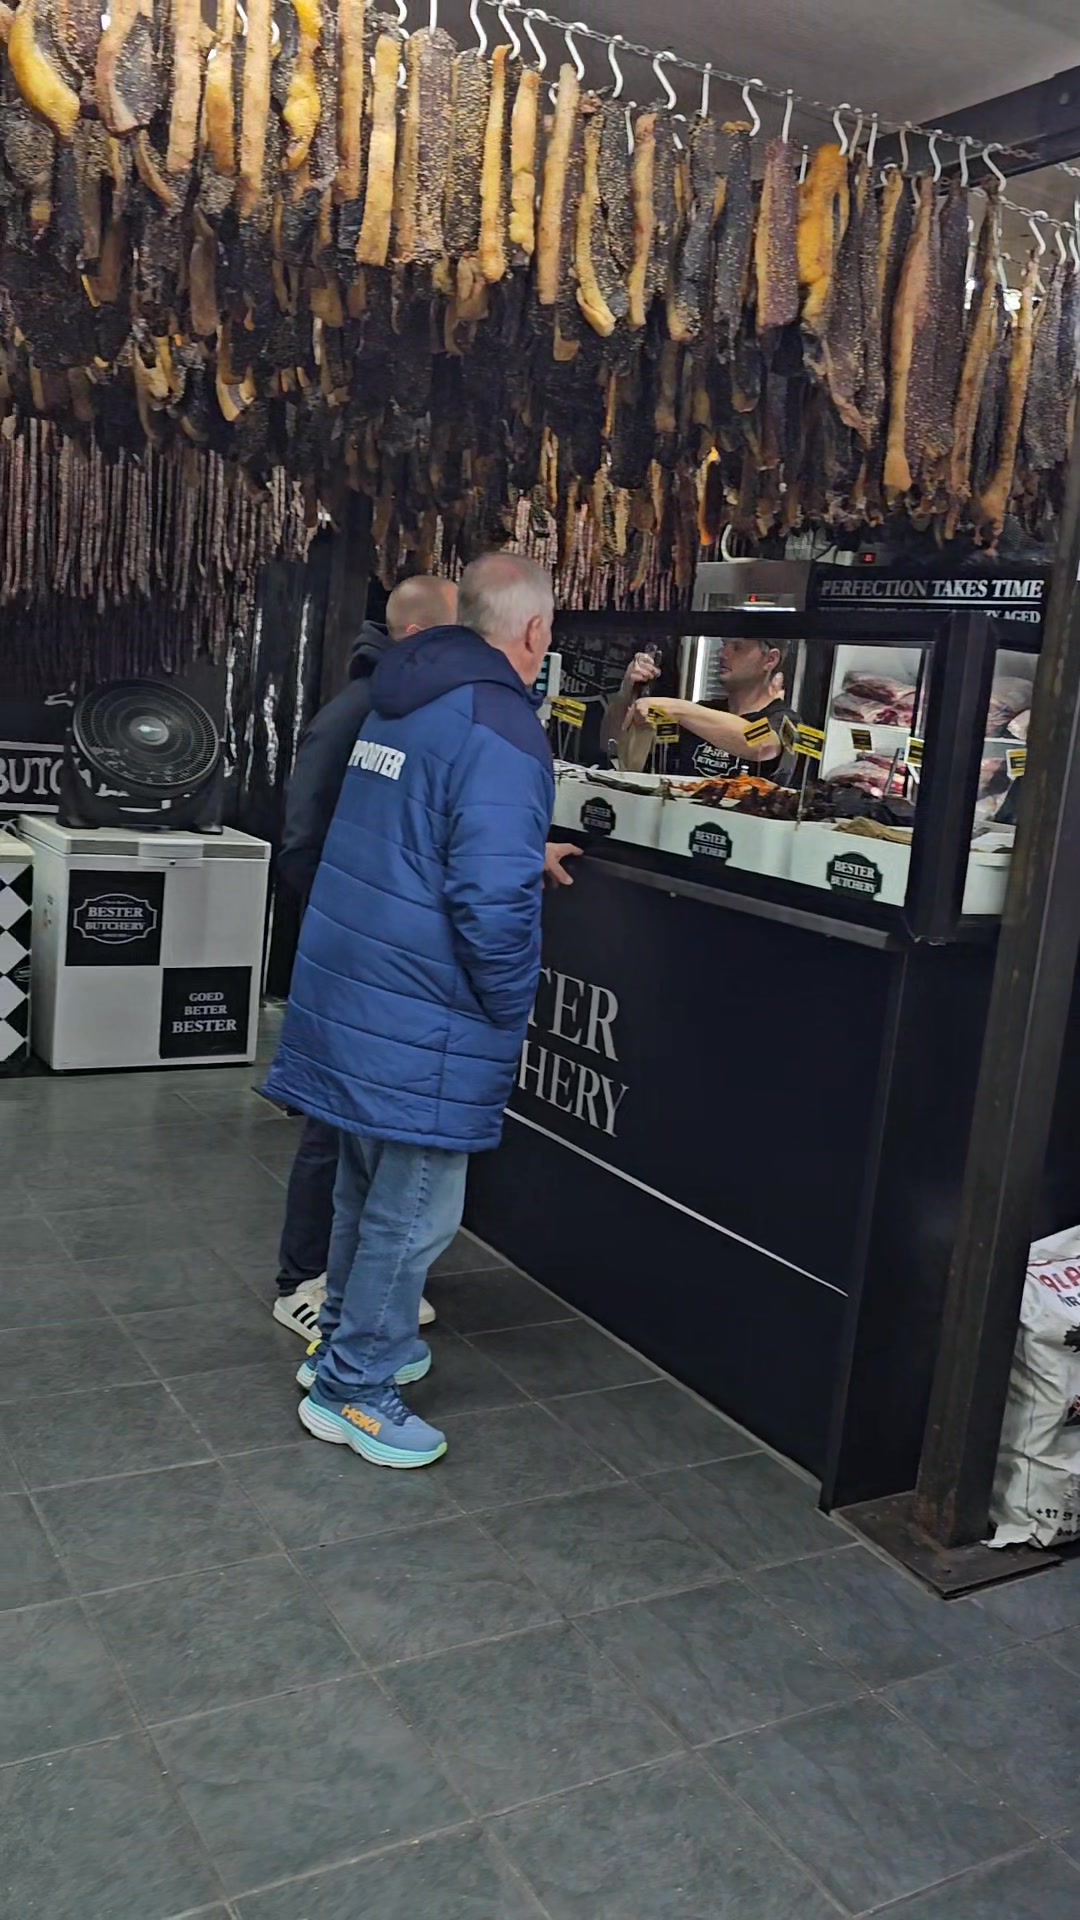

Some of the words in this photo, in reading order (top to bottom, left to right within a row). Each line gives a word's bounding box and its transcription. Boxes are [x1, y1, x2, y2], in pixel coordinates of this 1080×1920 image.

[820, 580, 929, 597] PERFECTION
[932, 580, 988, 598] TAKES
[990, 580, 1045, 599] TIME
[584, 804, 612, 818] BESTER
[695, 830, 728, 846] BESTER
[833, 860, 876, 879] BESTER
[830, 875, 877, 894] BUTCHERY
[87, 906, 144, 918] BESTER
[84, 921, 147, 931] BUTCHERY
[188, 991, 225, 1002] GOED
[184, 1004, 228, 1016] BETER
[172, 1018, 238, 1034] BESTER
[341, 1404, 382, 1436] HOKA
